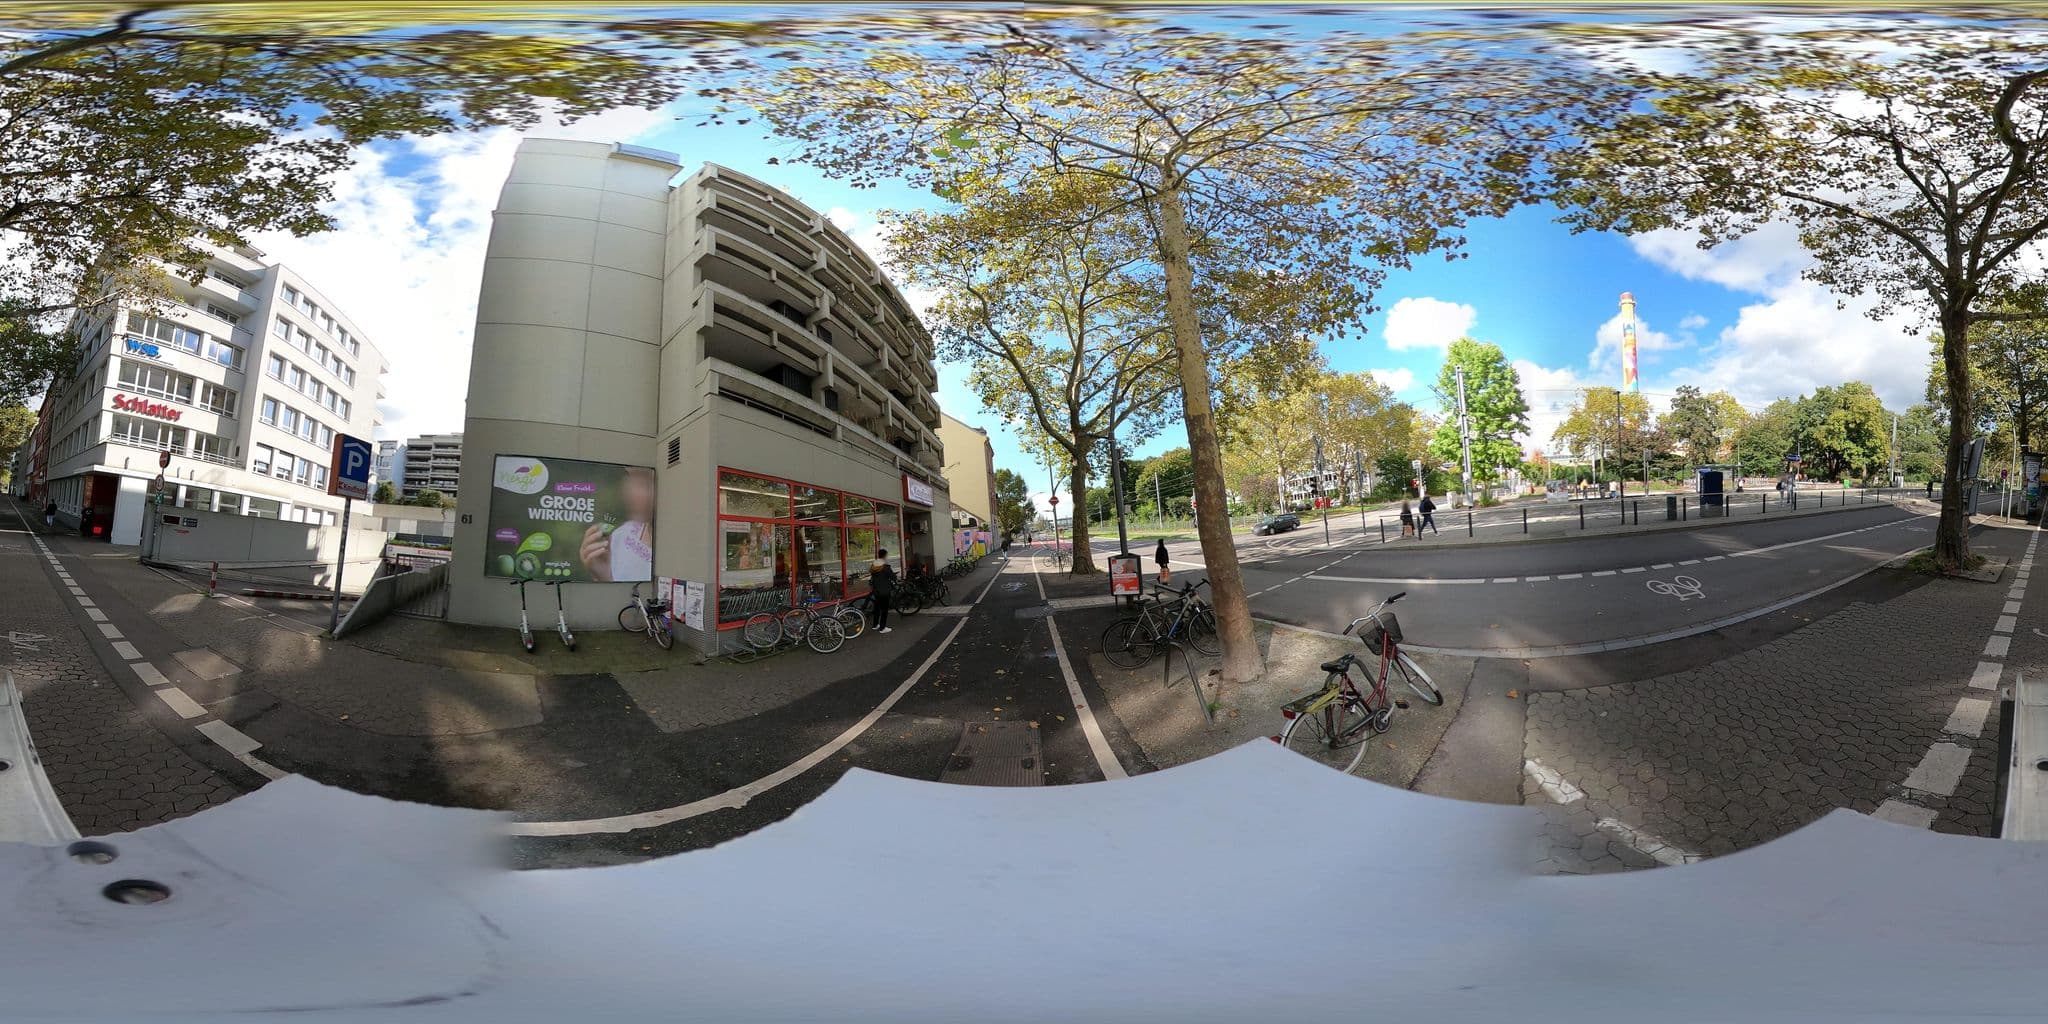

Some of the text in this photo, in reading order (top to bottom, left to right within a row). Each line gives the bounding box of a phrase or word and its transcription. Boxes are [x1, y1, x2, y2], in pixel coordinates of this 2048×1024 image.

[112, 394, 183, 421] Schlatter
[346, 450, 364, 475] P
[461, 514, 473, 524] 61
[528, 507, 594, 523] WIRKUNG
